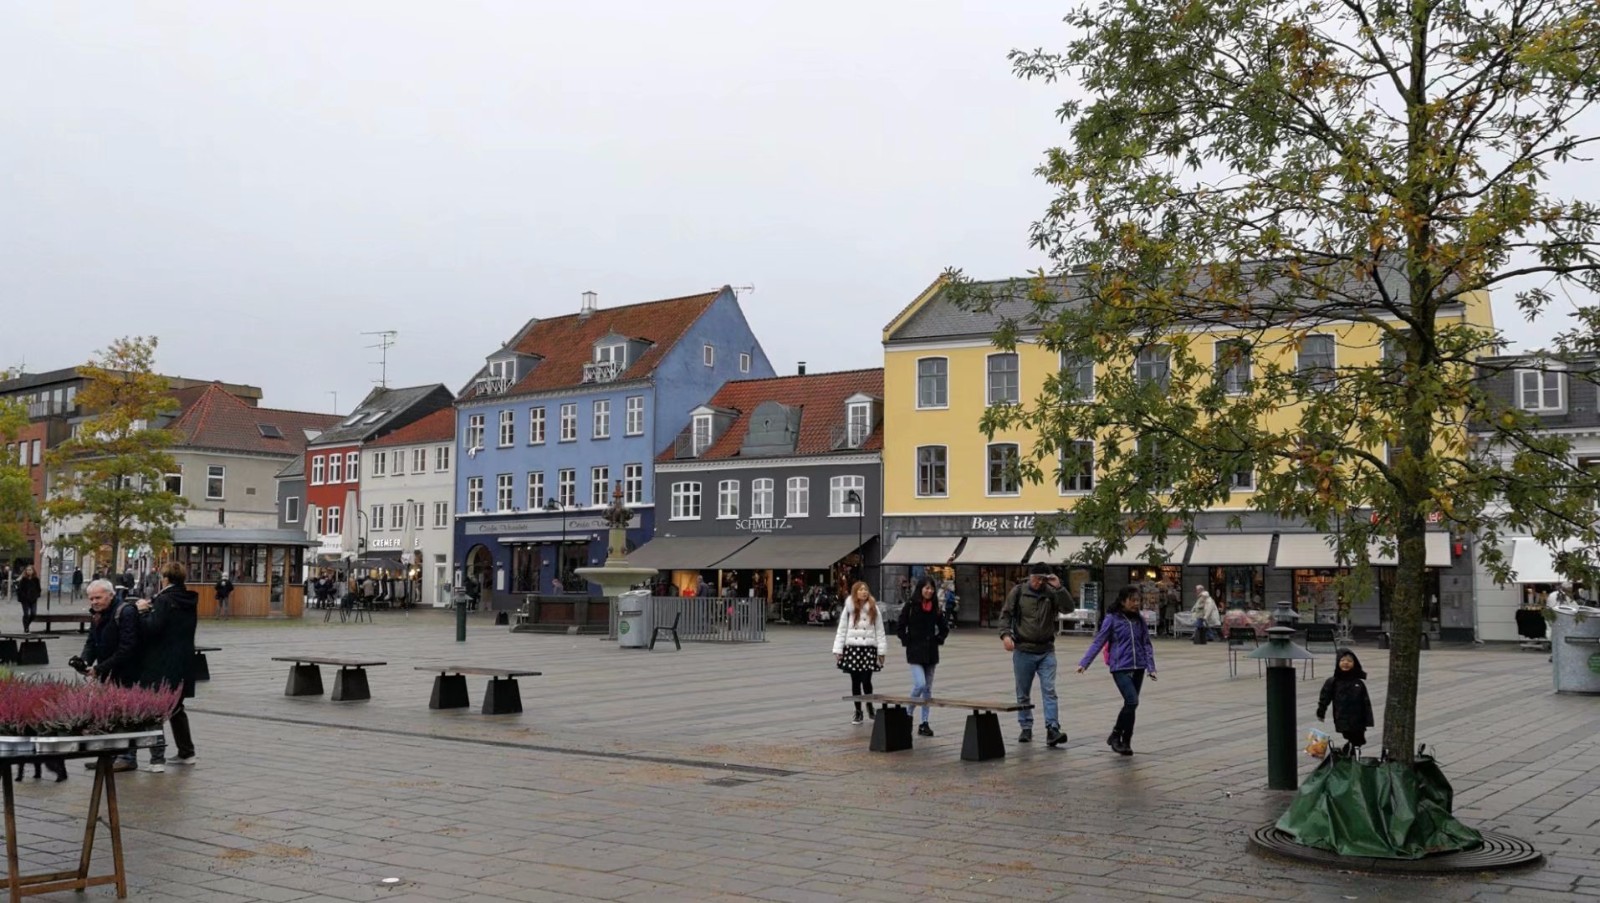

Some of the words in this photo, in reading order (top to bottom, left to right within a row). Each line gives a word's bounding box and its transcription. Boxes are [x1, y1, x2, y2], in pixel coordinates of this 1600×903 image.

[735, 518, 787, 530] SCHMELTZ
[971, 516, 998, 532] Bog
[1000, 518, 1010, 529] &
